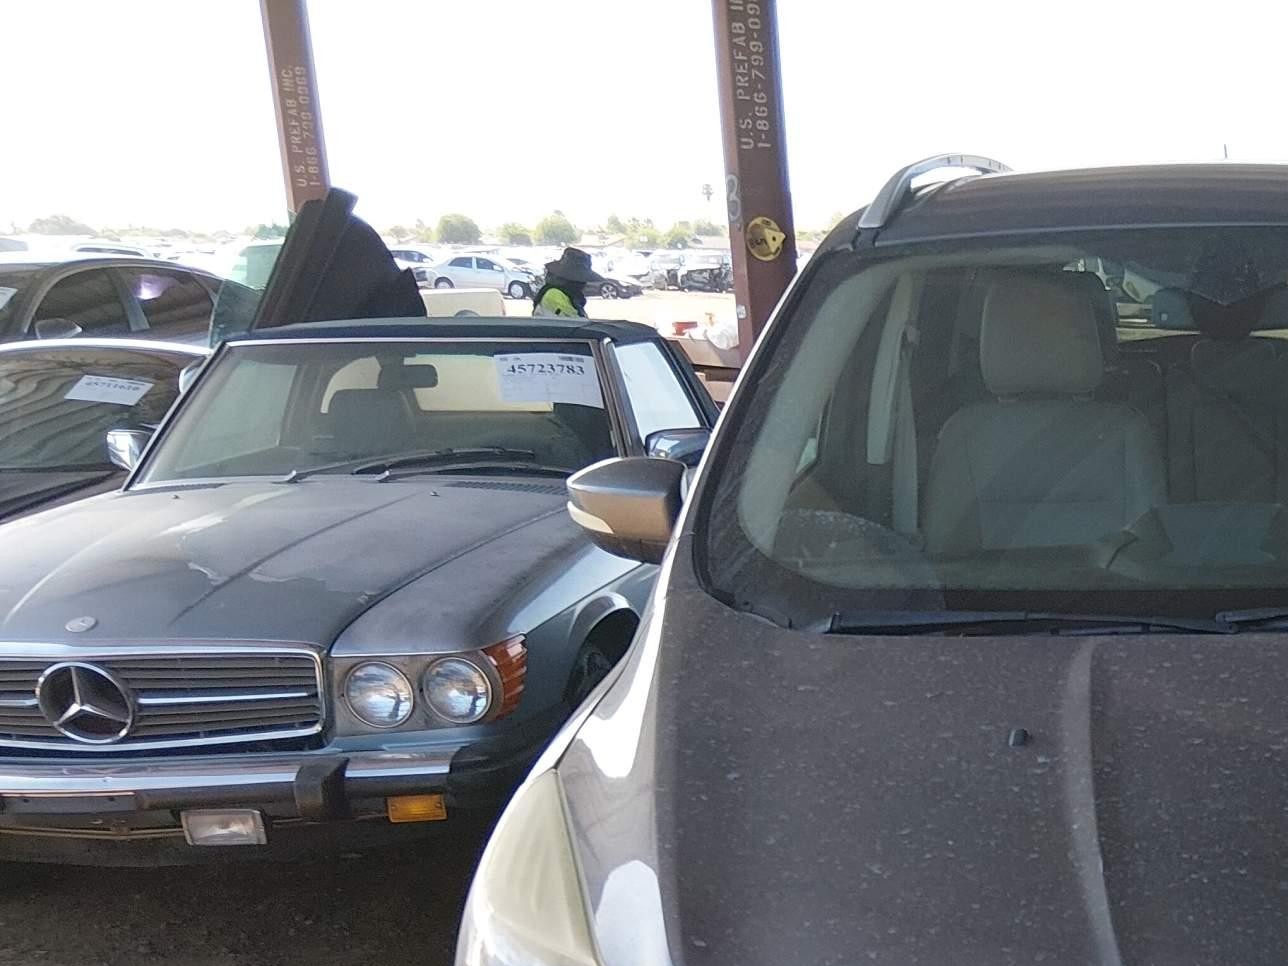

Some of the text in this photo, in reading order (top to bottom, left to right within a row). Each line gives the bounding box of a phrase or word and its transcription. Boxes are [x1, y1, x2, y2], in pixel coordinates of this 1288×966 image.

[732, 22, 751, 100] PREFAB
[286, 99, 303, 153] PREFAB
[739, 113, 754, 150] U.S.
[295, 161, 308, 187] U.S.
[507, 363, 585, 375] 45723783
